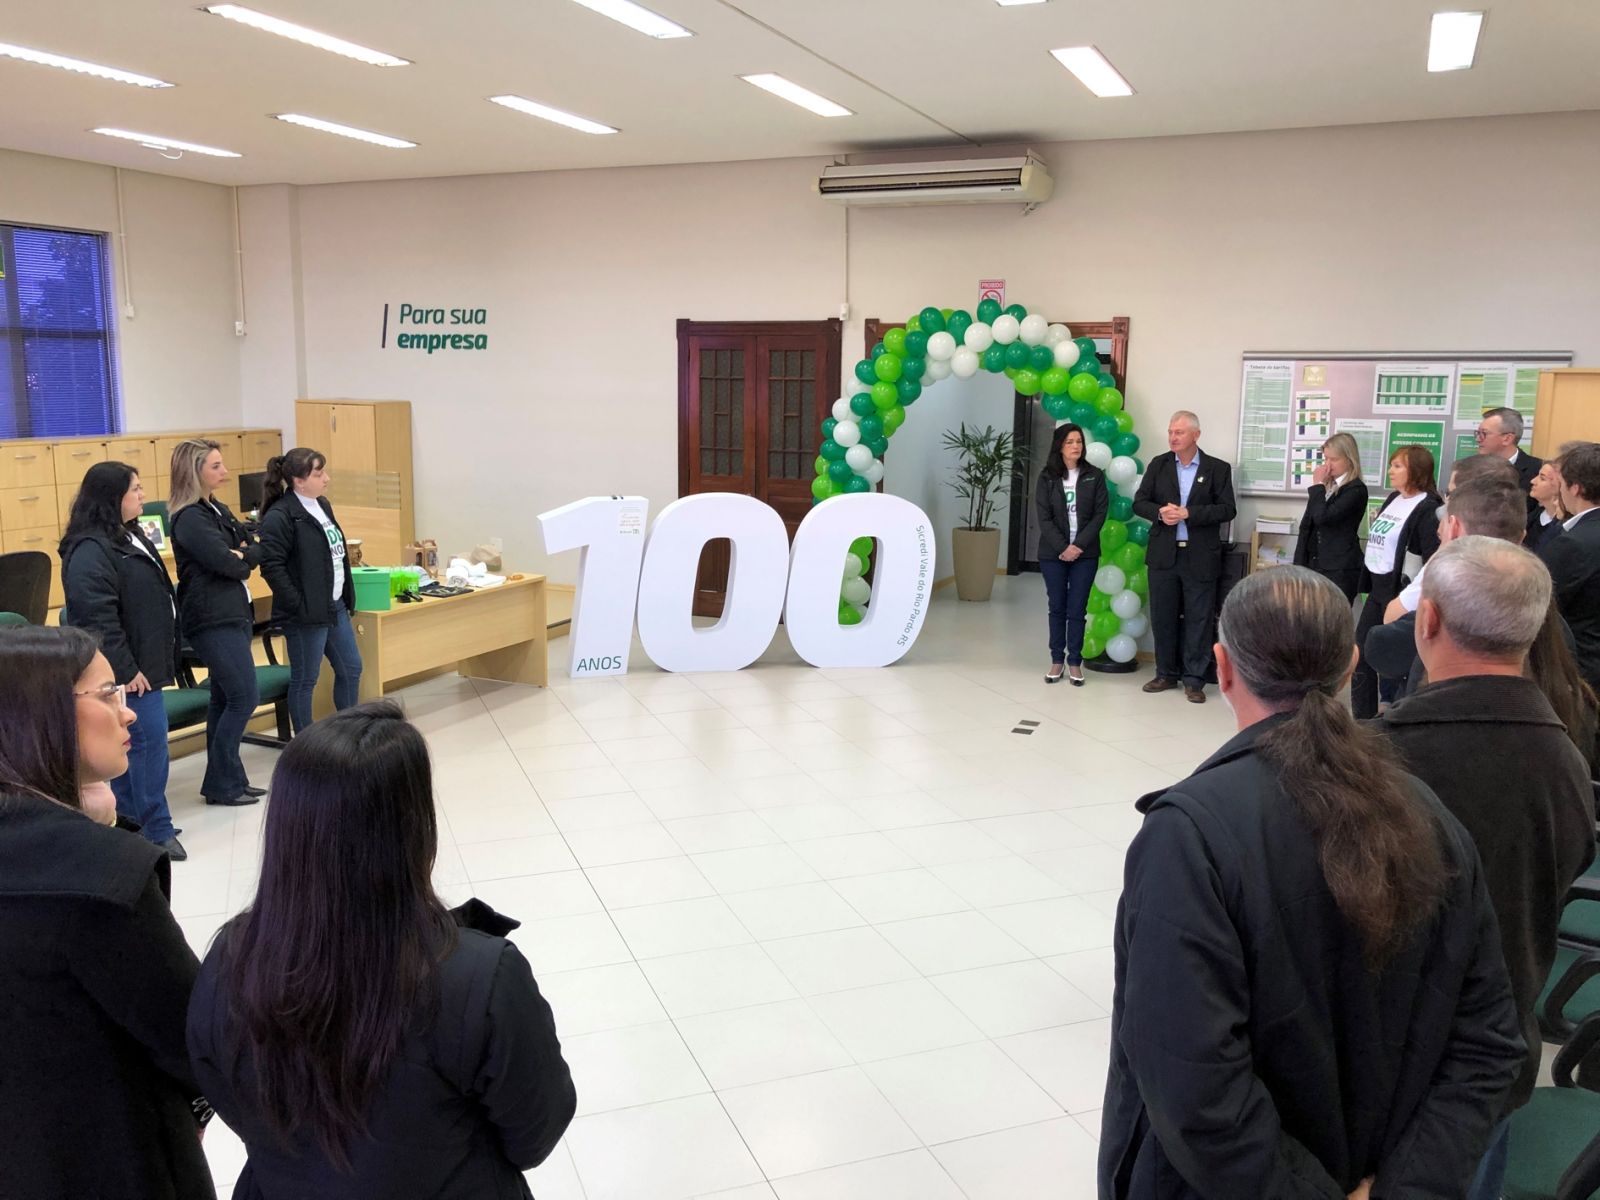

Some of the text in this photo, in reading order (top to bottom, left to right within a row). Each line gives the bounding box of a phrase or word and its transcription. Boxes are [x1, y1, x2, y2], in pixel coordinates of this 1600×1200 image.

[400, 303, 487, 325] Para sua
[397, 332, 488, 354] empresa
[537, 492, 936, 677] 100
[896, 525, 929, 647] Sicredi Vale do Rio Pardo RS
[576, 655, 622, 672] ANOS
